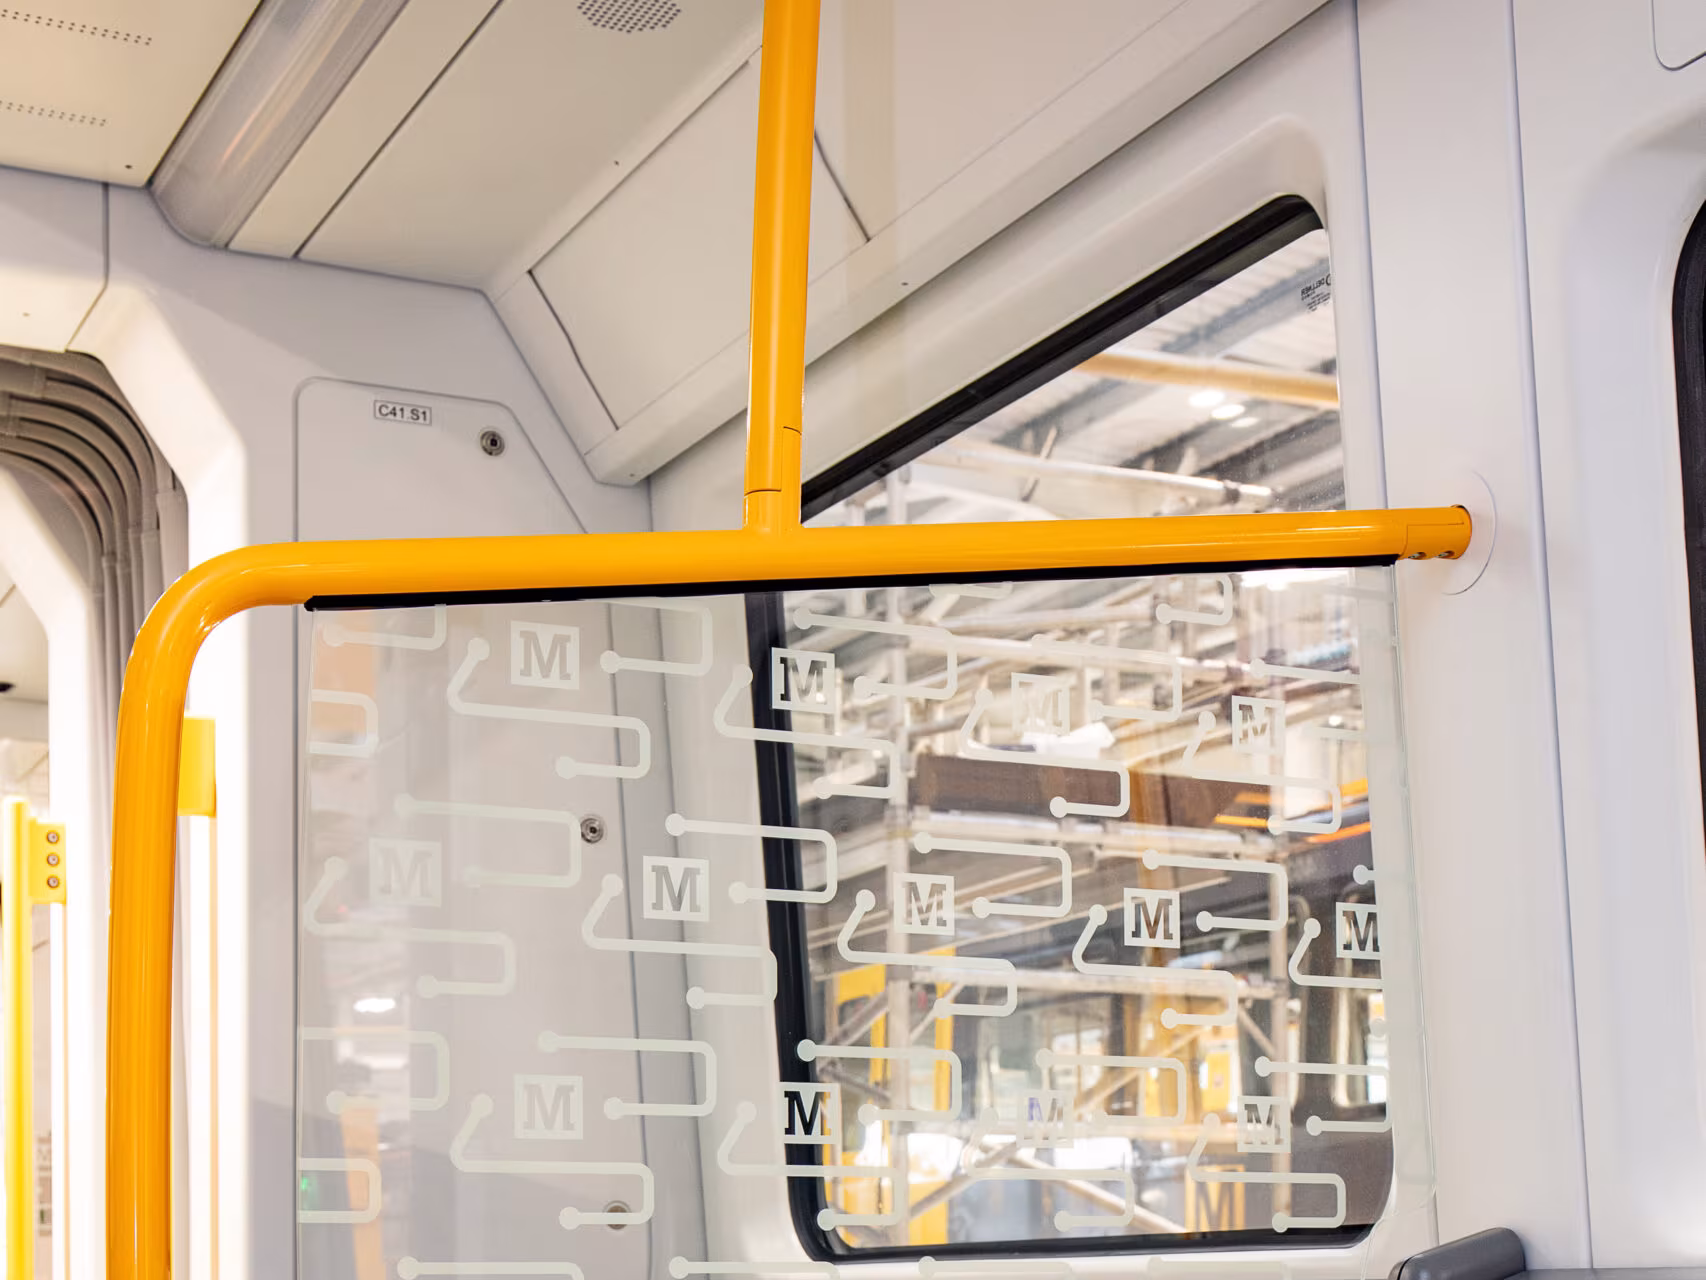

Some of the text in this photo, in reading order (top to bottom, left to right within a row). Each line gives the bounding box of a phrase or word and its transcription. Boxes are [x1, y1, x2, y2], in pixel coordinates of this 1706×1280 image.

[517, 626, 575, 683] M
[776, 653, 830, 708] M
[1235, 700, 1282, 752] M
[378, 846, 436, 901] M
[648, 862, 704, 916] M
[901, 878, 950, 930] M
[1128, 893, 1177, 943] M
[1340, 905, 1380, 955] M
[520, 1079, 579, 1134] M
[781, 1087, 833, 1139] M
[1241, 1100, 1287, 1148] M
